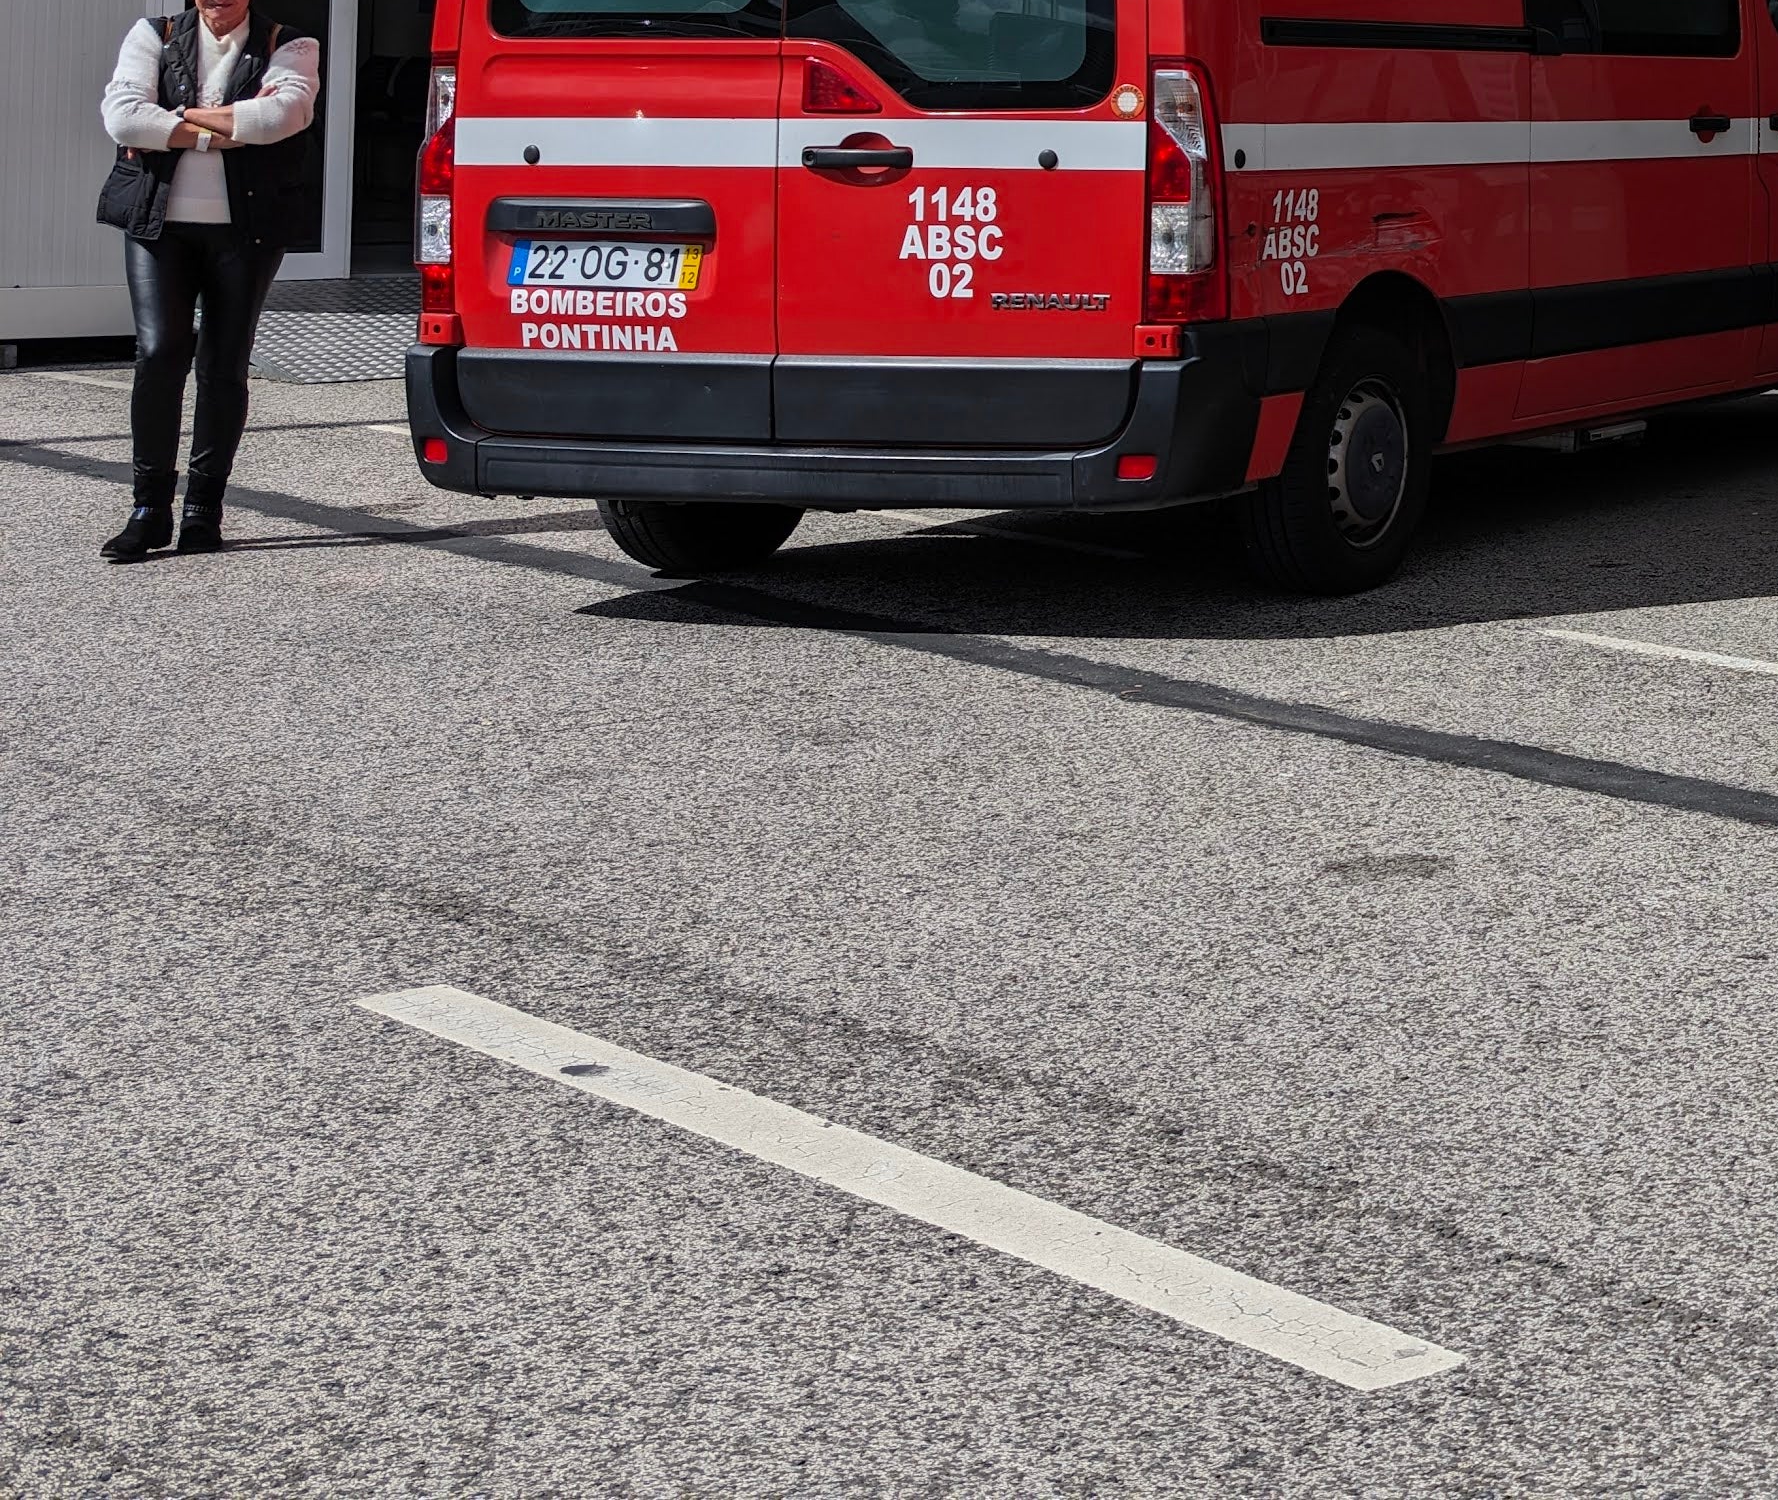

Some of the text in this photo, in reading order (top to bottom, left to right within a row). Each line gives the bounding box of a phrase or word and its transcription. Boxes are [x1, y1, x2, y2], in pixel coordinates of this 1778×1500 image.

[536, 211, 653, 229] MASTER
[908, 186, 997, 222] 1148
[1273, 188, 1319, 223] 1148
[899, 225, 1004, 260] ABSC
[1262, 224, 1320, 260] ABSC
[681, 271, 694, 284] 12
[928, 263, 974, 298] 02
[1281, 261, 1309, 295] 02
[510, 288, 687, 319] BOMBEIROS
[990, 293, 1111, 311] RENAULT
[521, 323, 679, 352] PONTINHA
